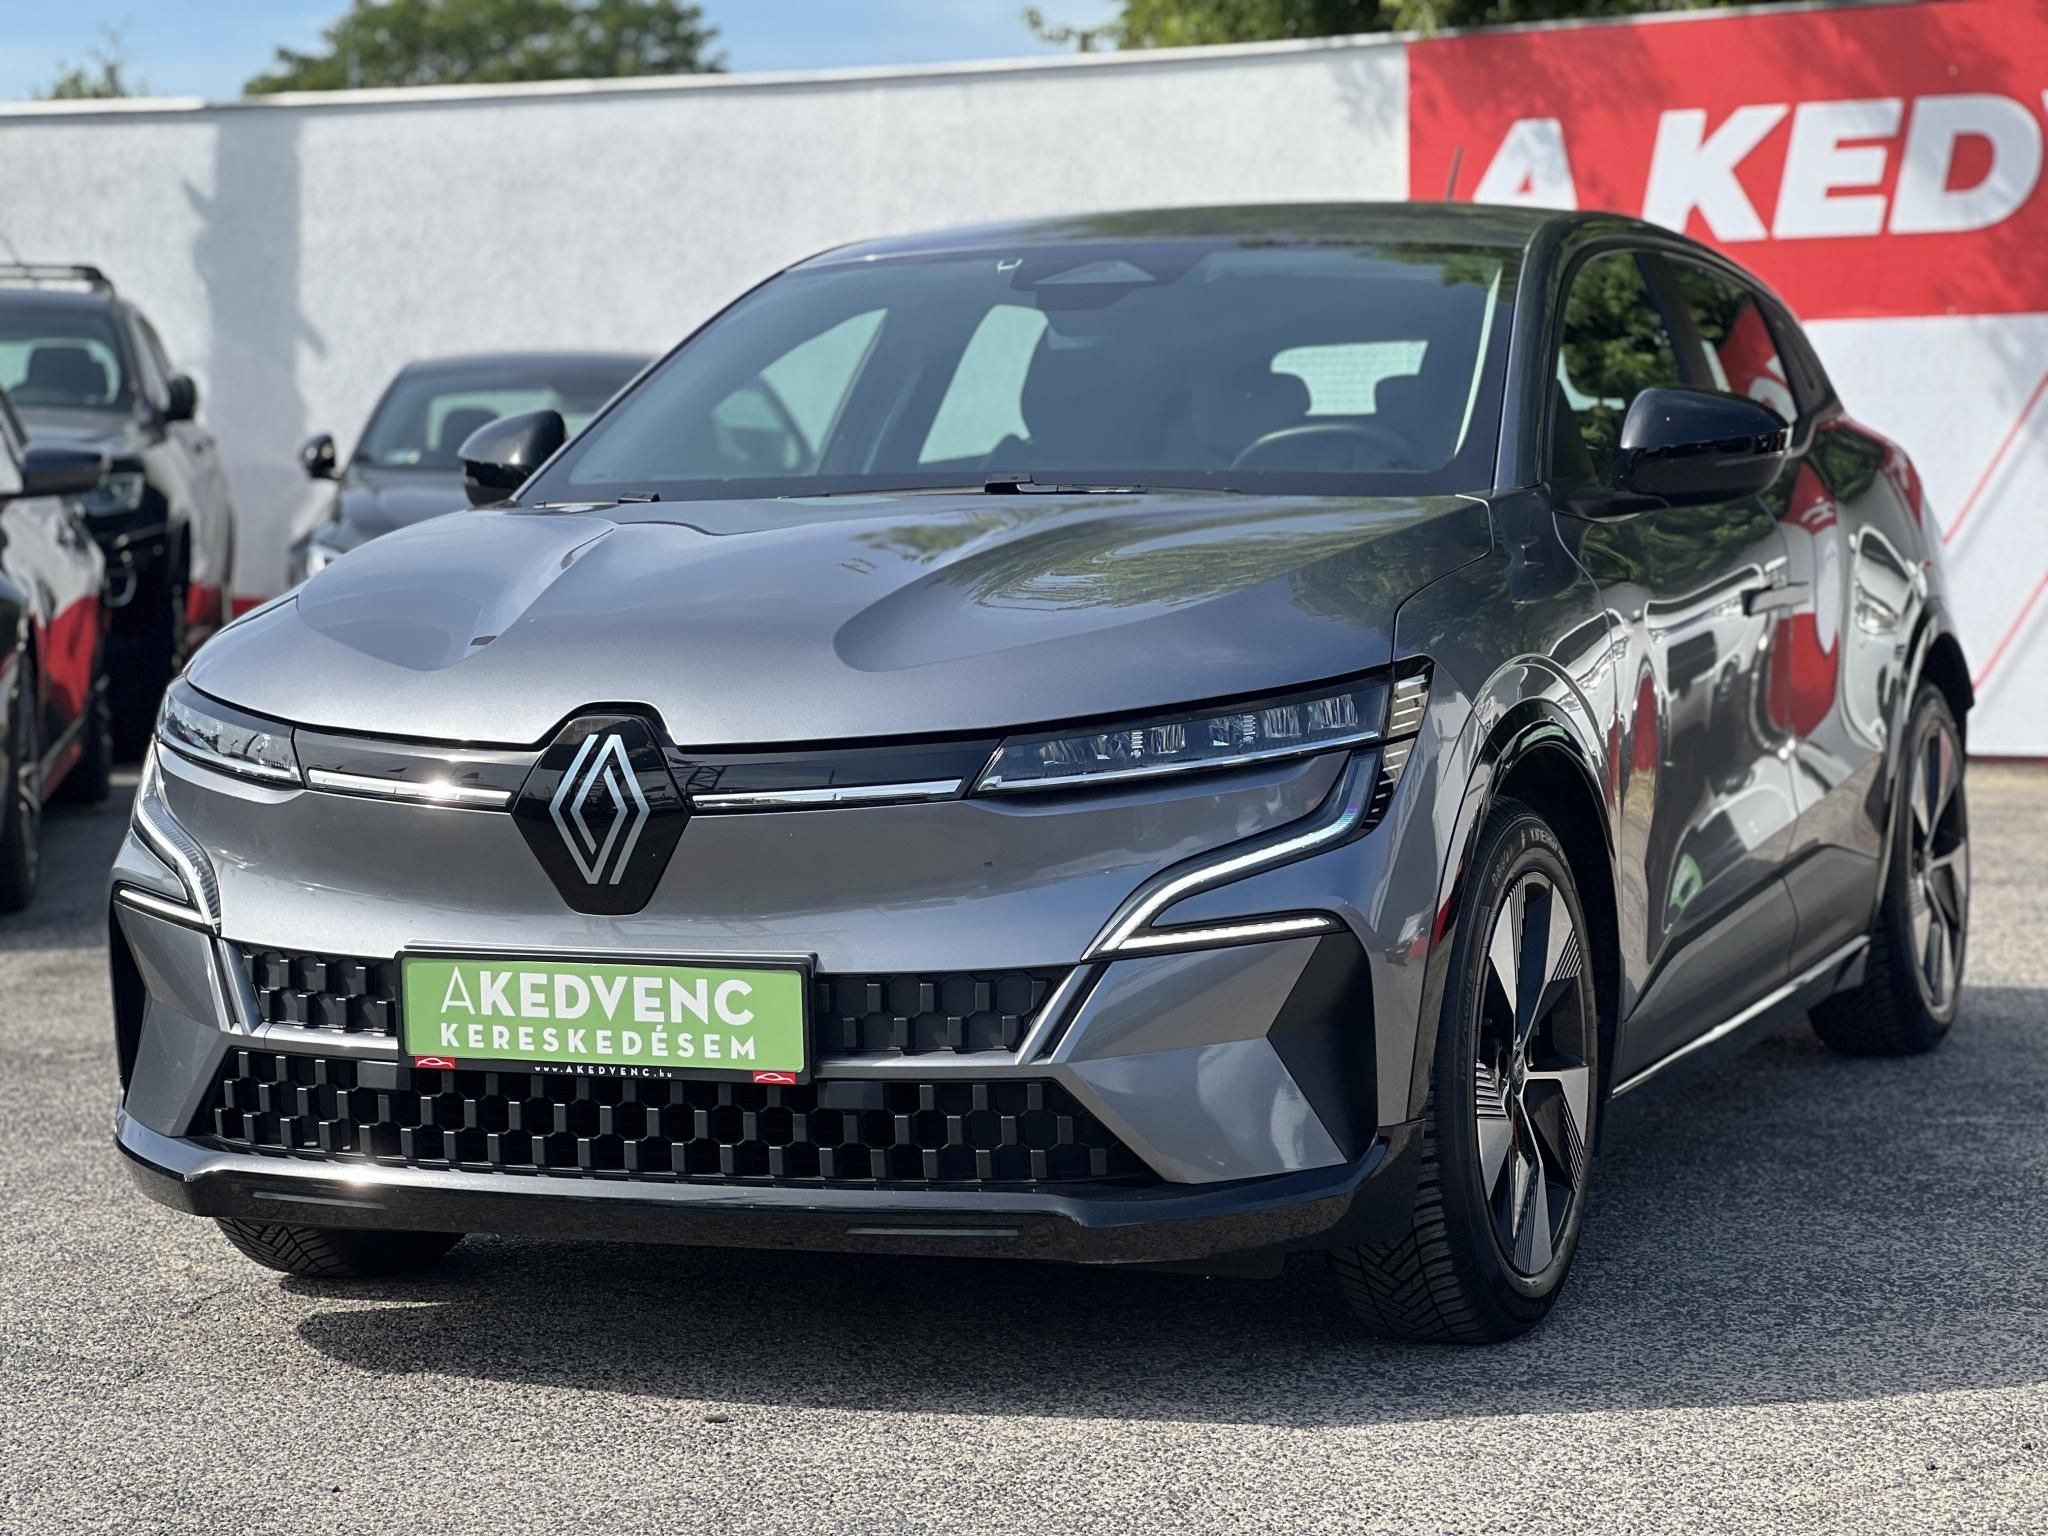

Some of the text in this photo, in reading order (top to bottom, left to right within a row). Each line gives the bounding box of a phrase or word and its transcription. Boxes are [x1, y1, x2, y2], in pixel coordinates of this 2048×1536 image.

[1473, 91, 2048, 242] A KED
[440, 1022, 756, 1060] KERESKEDÉSEM
[534, 1064, 673, 1078] www.AKEDVENC.hu
